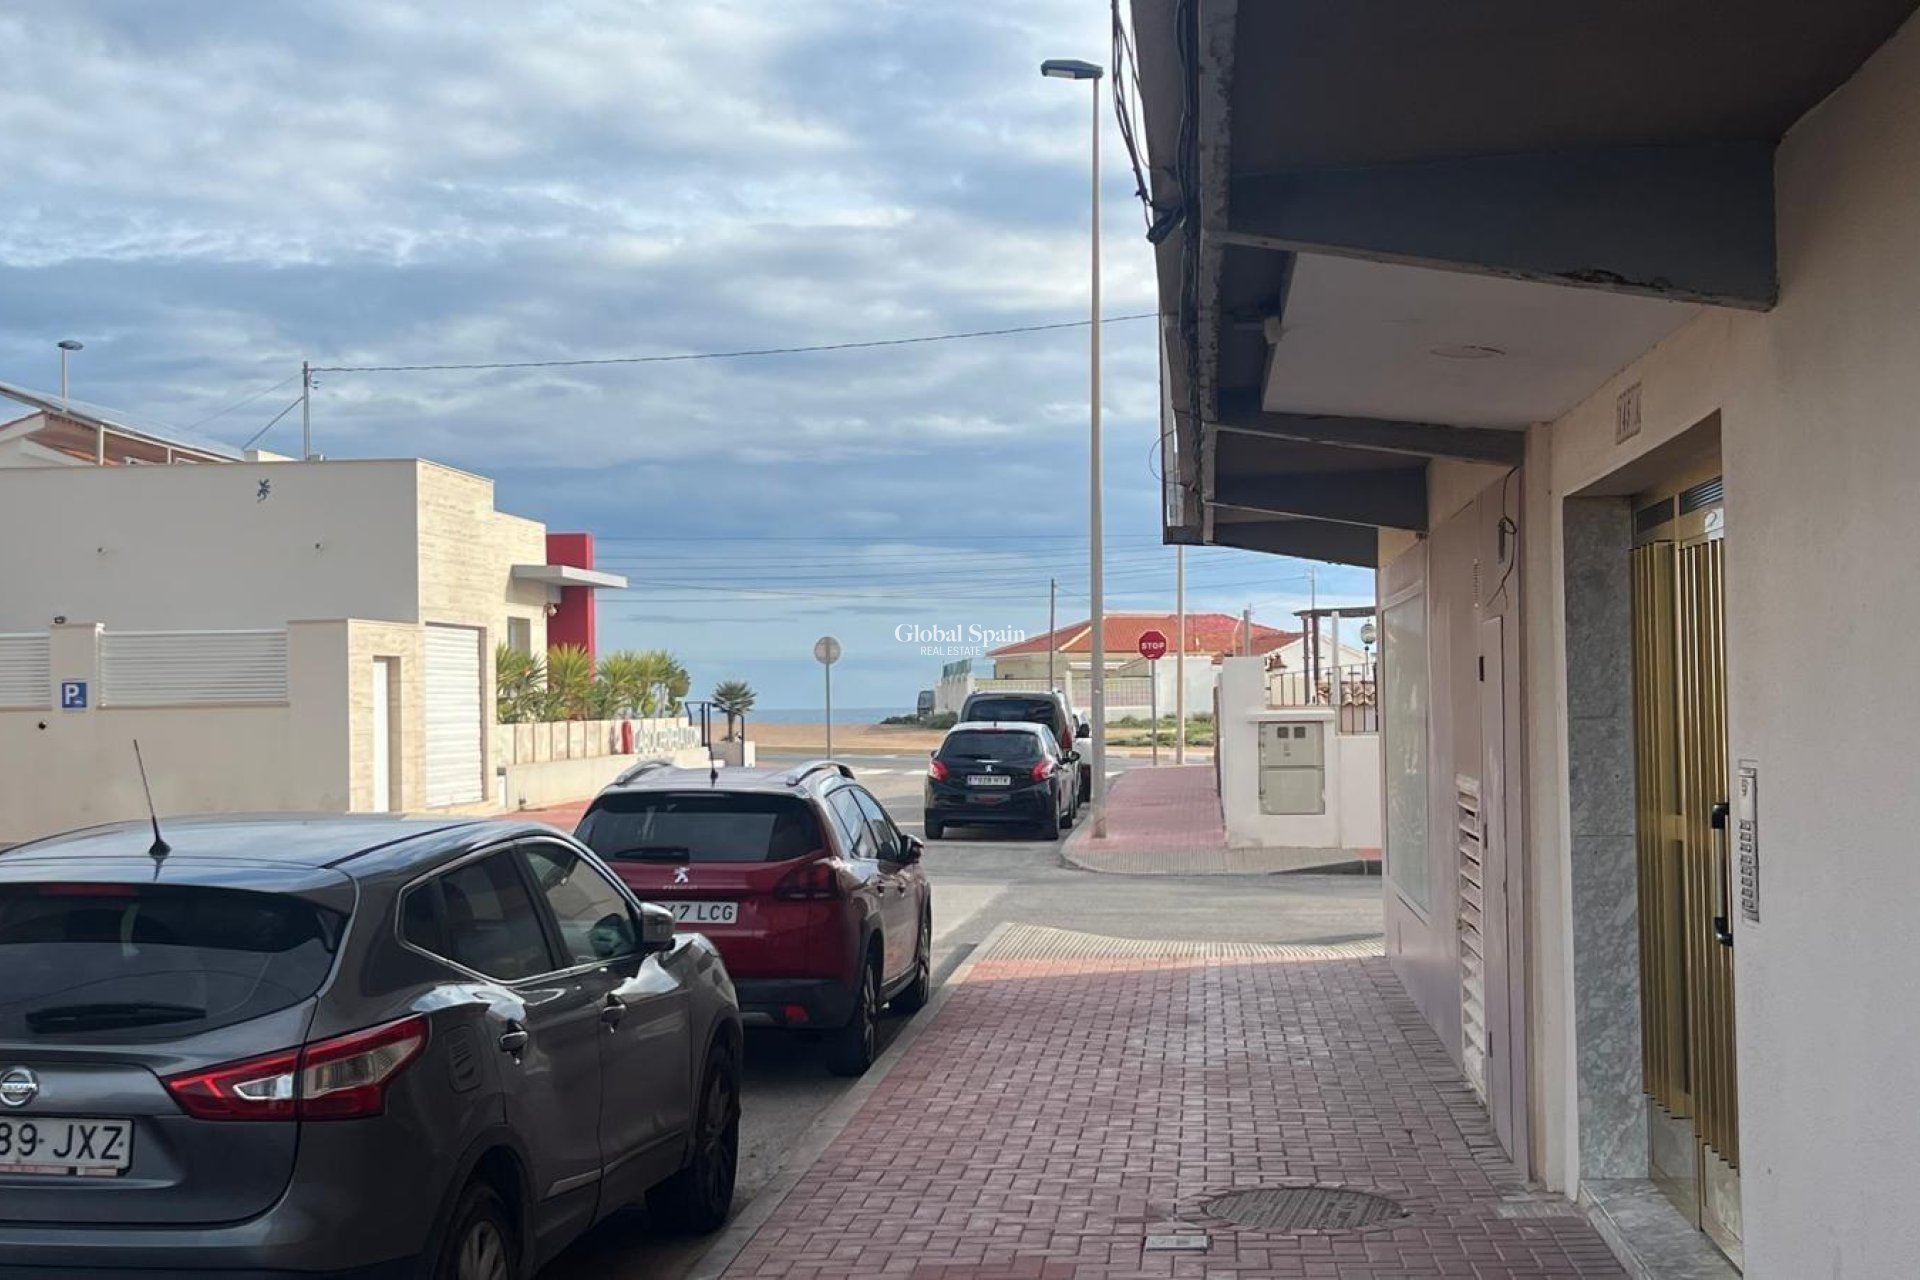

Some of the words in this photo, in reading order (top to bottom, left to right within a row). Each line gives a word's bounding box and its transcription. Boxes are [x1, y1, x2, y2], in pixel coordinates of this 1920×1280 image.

[1141, 642, 1165, 650] STOP
[64, 684, 80, 705] P
[697, 904, 733, 921] LCG
[53, 1124, 123, 1160] JXZ
